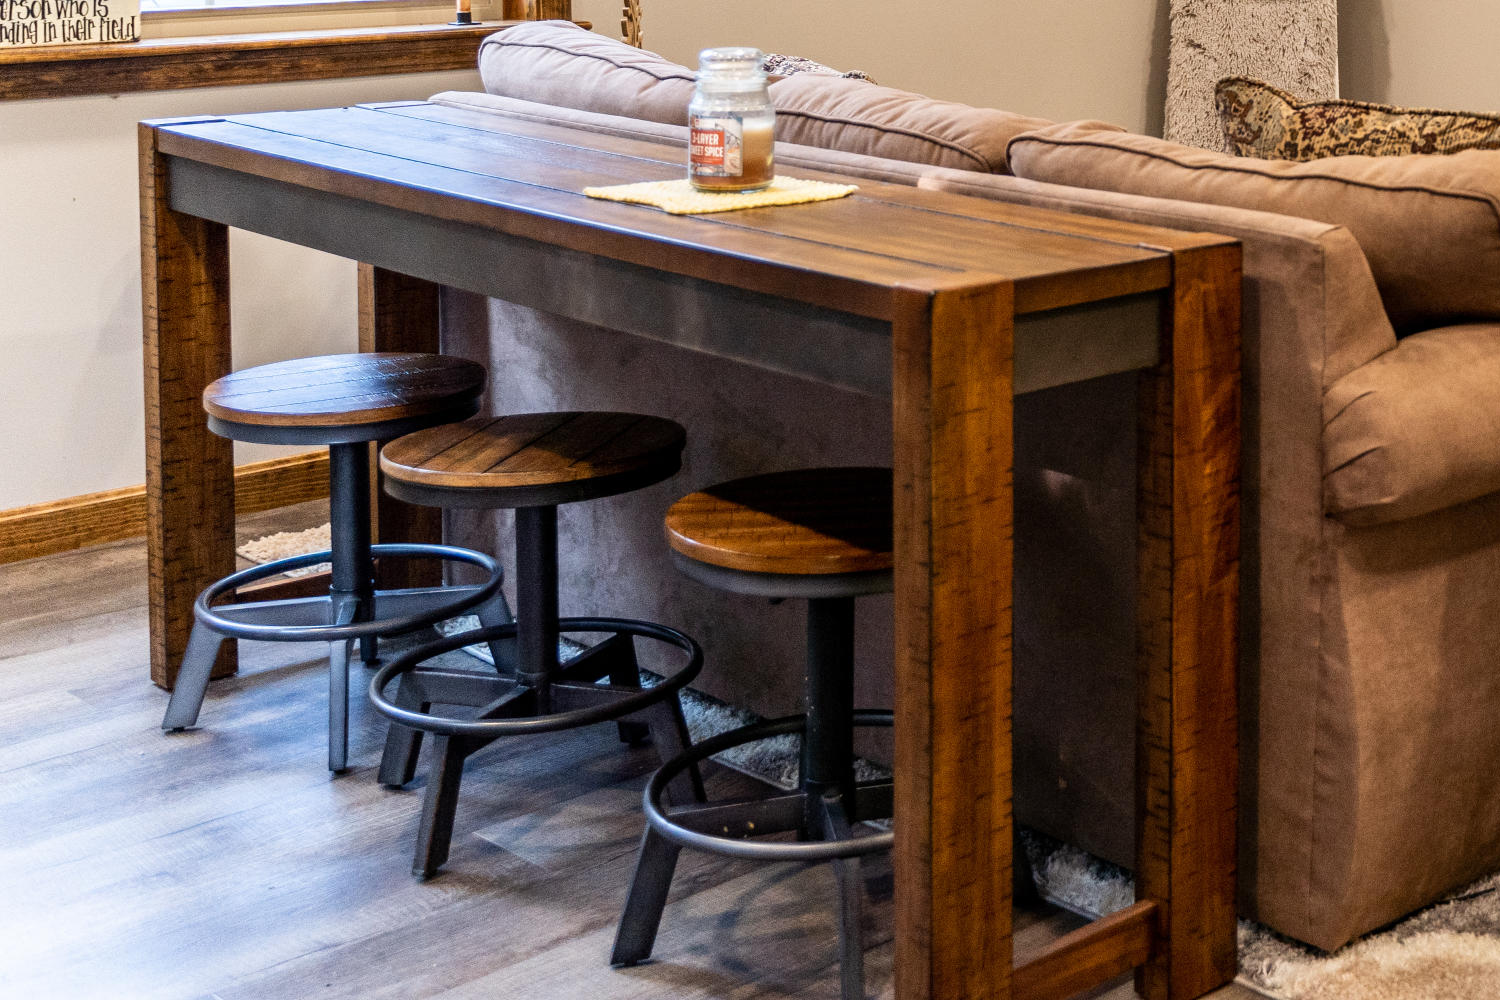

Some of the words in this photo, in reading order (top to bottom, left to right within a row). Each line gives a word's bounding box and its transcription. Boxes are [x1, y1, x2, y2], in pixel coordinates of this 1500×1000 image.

[43, 20, 58, 43] in
[62, 16, 96, 43] their
[99, 15, 137, 42] field
[704, 146, 724, 158] SPICE
